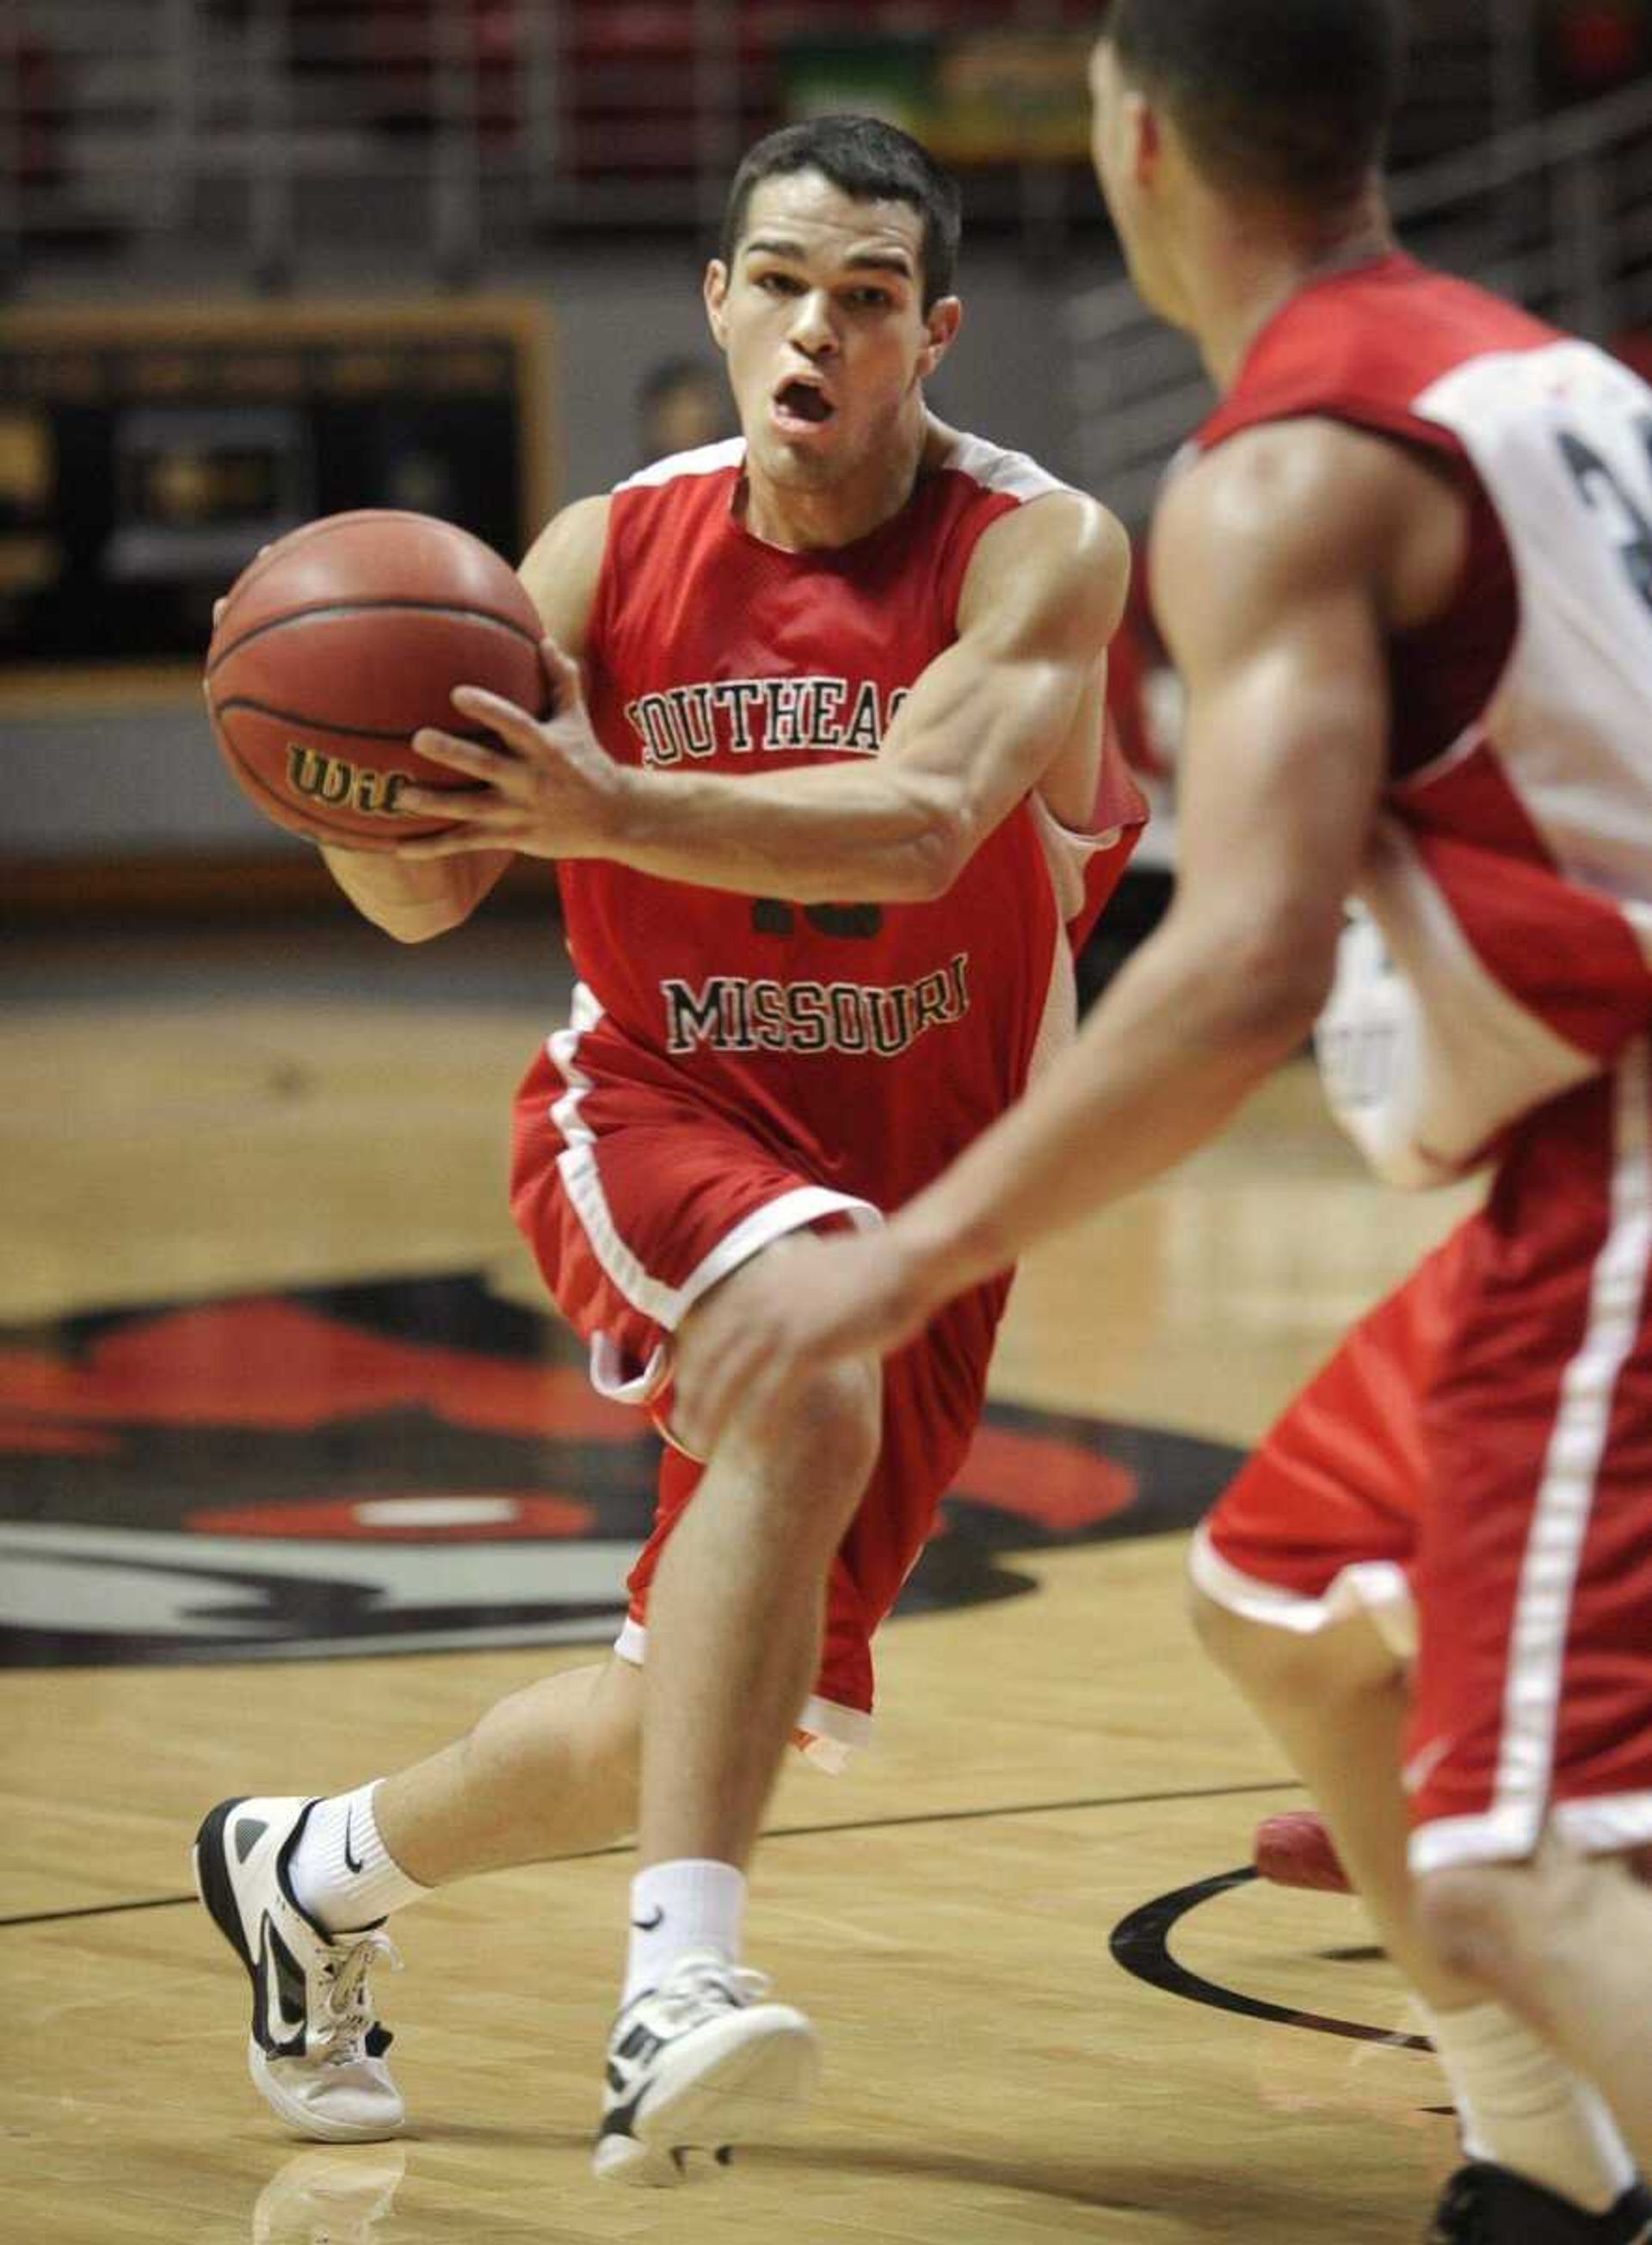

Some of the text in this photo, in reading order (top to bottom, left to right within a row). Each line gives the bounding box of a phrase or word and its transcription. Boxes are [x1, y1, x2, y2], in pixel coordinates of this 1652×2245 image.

[624, 677, 909, 768] OUTHEA
[287, 743, 415, 818] Wil
[662, 953, 971, 1056] MISSOURI
